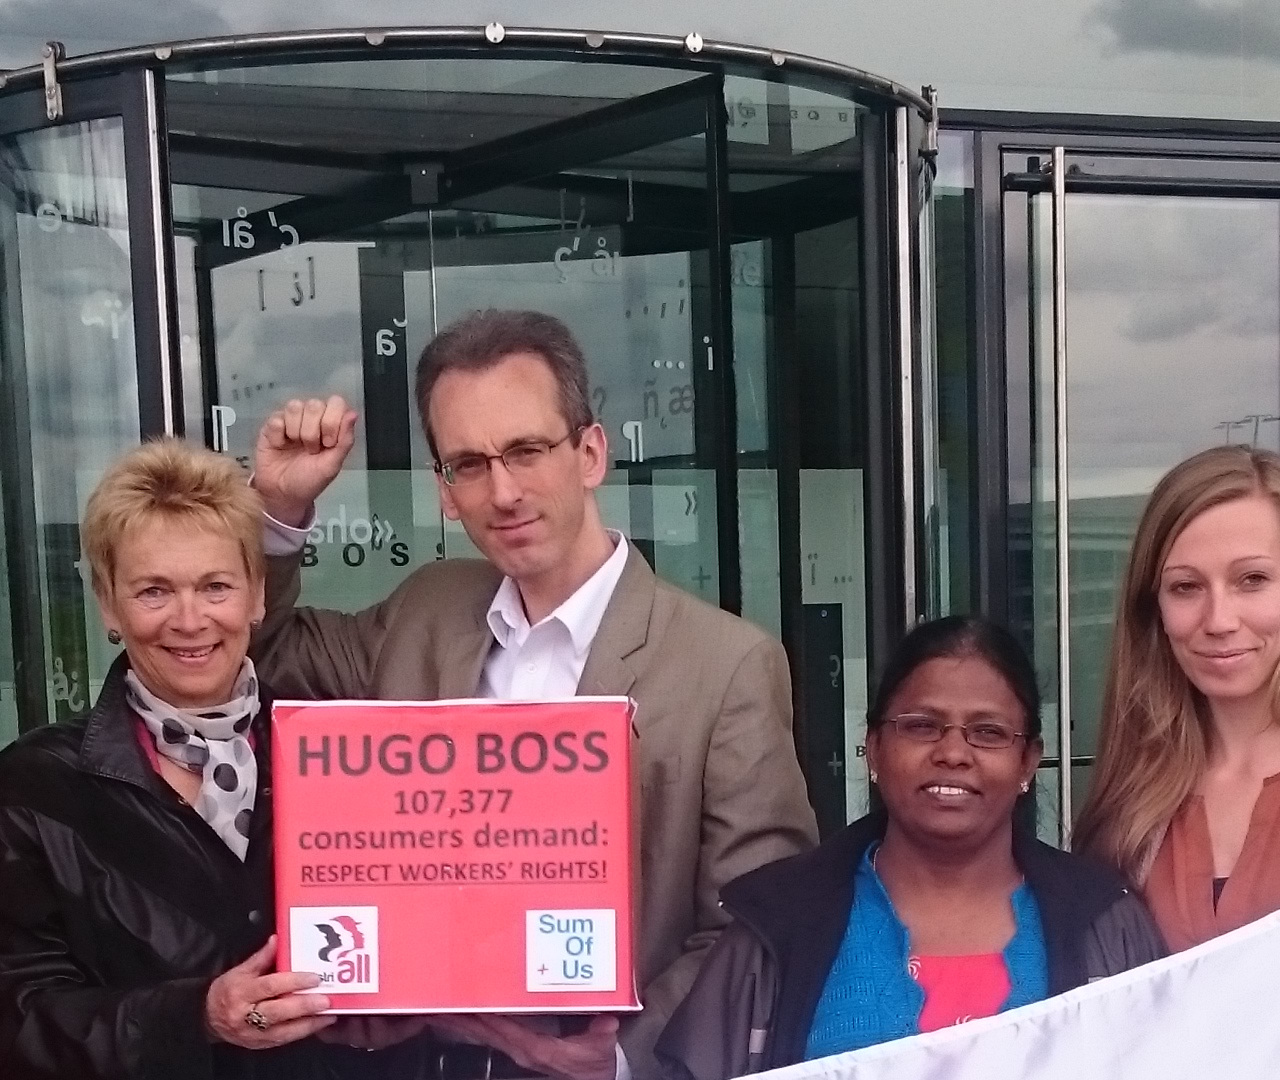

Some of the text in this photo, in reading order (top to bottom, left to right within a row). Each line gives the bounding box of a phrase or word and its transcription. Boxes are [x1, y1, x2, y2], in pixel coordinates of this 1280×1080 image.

[297, 730, 610, 777] HUGO BOSS
[393, 788, 513, 818] 107,377
[298, 820, 609, 851] consumers demand:
[300, 863, 393, 883] RESPECT
[521, 860, 608, 880] RIGHTS!
[538, 914, 594, 934] Sum
[565, 936, 594, 956] Of
[336, 954, 371, 984] all
[562, 959, 594, 980] Us
